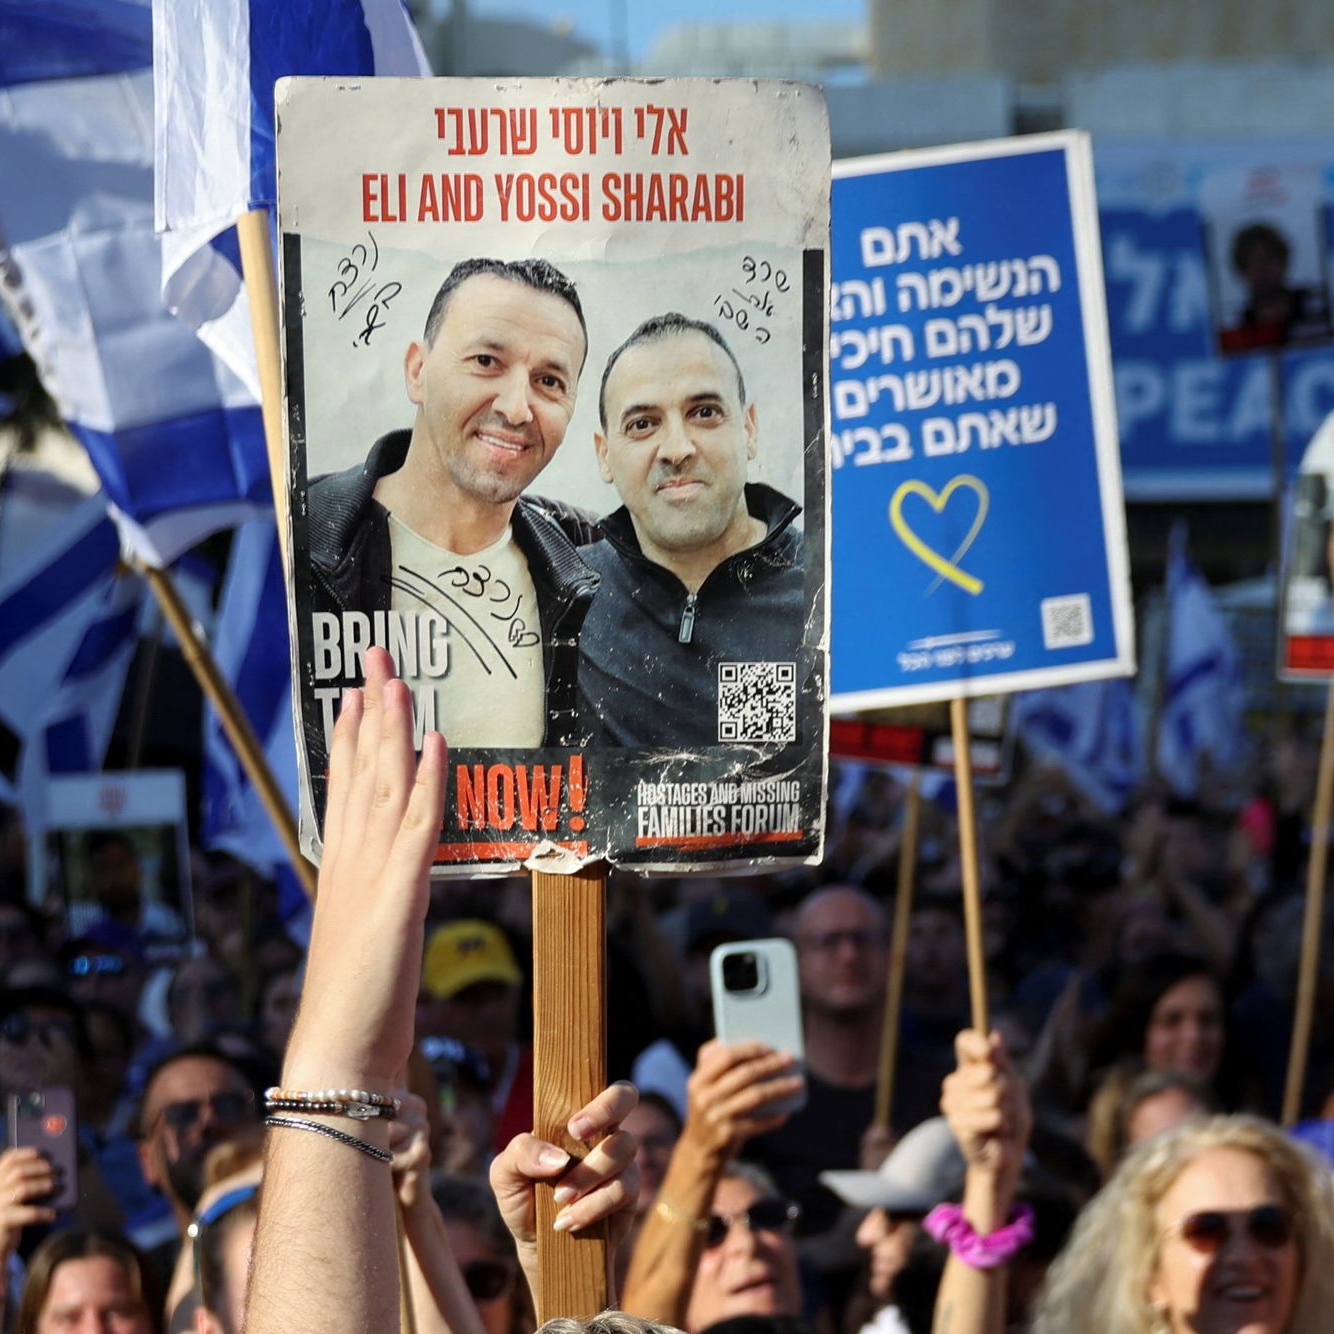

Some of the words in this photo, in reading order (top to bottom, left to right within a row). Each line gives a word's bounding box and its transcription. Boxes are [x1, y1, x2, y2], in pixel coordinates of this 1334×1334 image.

[434, 107, 538, 155] שרעבי
[548, 107, 623, 155] ויוסי
[634, 104, 689, 155] אלי
[362, 173, 407, 222] ELI
[417, 173, 485, 222] AND
[494, 172, 591, 222] YOSSI
[602, 172, 745, 222] SHARABI
[860, 216, 963, 268] אתם
[896, 254, 1062, 313] הנשימה
[924, 303, 1053, 359] שלהם
[833, 358, 1022, 420] מאושרים
[921, 401, 1058, 458] שאתם
[311, 610, 450, 680] BRING
[314, 684, 437, 752] TM
[456, 754, 589, 832] NOW!
[637, 781, 708, 806] HOSTAGES
[711, 781, 738, 806] AND
[740, 780, 801, 805] MISSING
[637, 804, 726, 838] FAMILIES
[731, 803, 800, 836] FORUM
